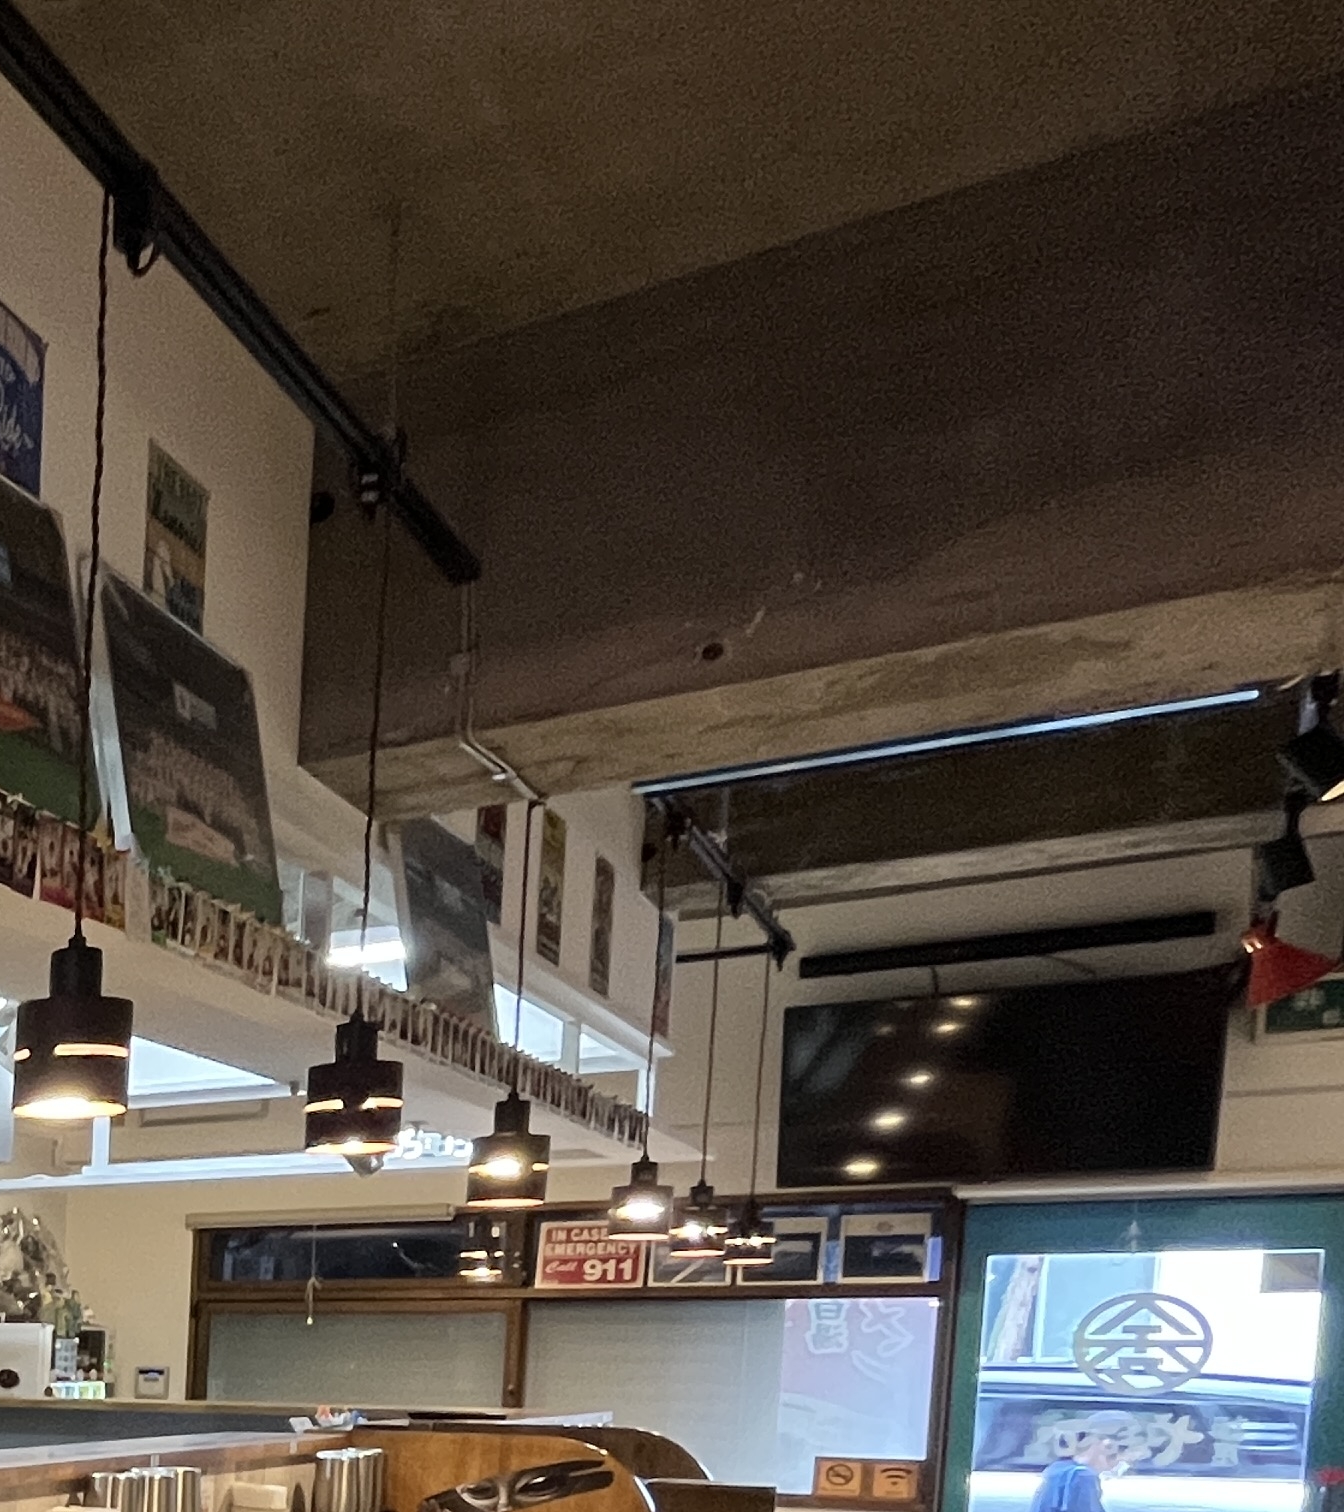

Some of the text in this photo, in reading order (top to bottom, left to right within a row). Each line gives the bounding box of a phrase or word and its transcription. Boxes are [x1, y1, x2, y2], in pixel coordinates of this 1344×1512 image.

[551, 1229, 568, 1242] IN
[544, 1241, 638, 1256] EMERGENCY
[544, 1258, 633, 1282] Call 911
